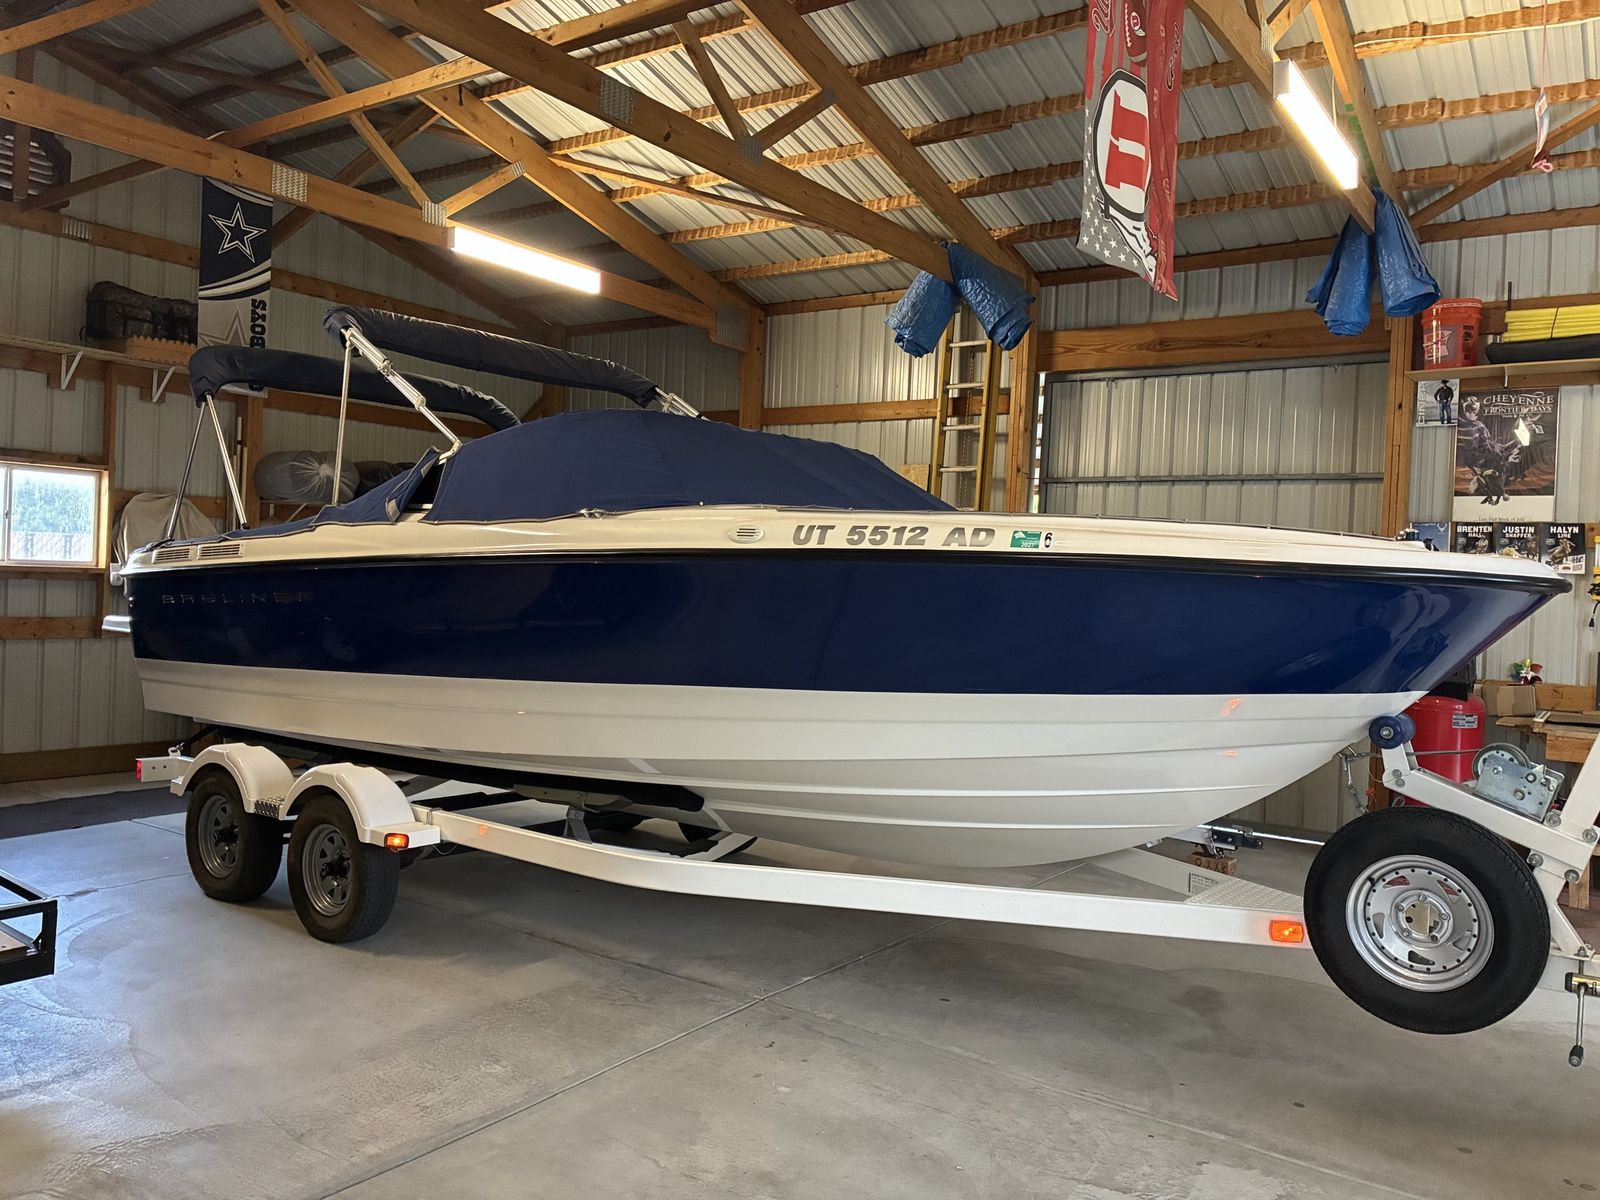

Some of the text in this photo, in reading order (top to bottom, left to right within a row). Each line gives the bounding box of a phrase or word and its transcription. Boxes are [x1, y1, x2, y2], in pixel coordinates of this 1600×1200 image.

[1483, 394, 1554, 406] CHEYENNE
[1456, 525, 1493, 533] BRENTEN
[1502, 526, 1535, 534] JUSTIN
[1550, 526, 1579, 534] HALYN
[792, 525, 996, 548] UT 5512 AD
[1044, 532, 1053, 548] 6
